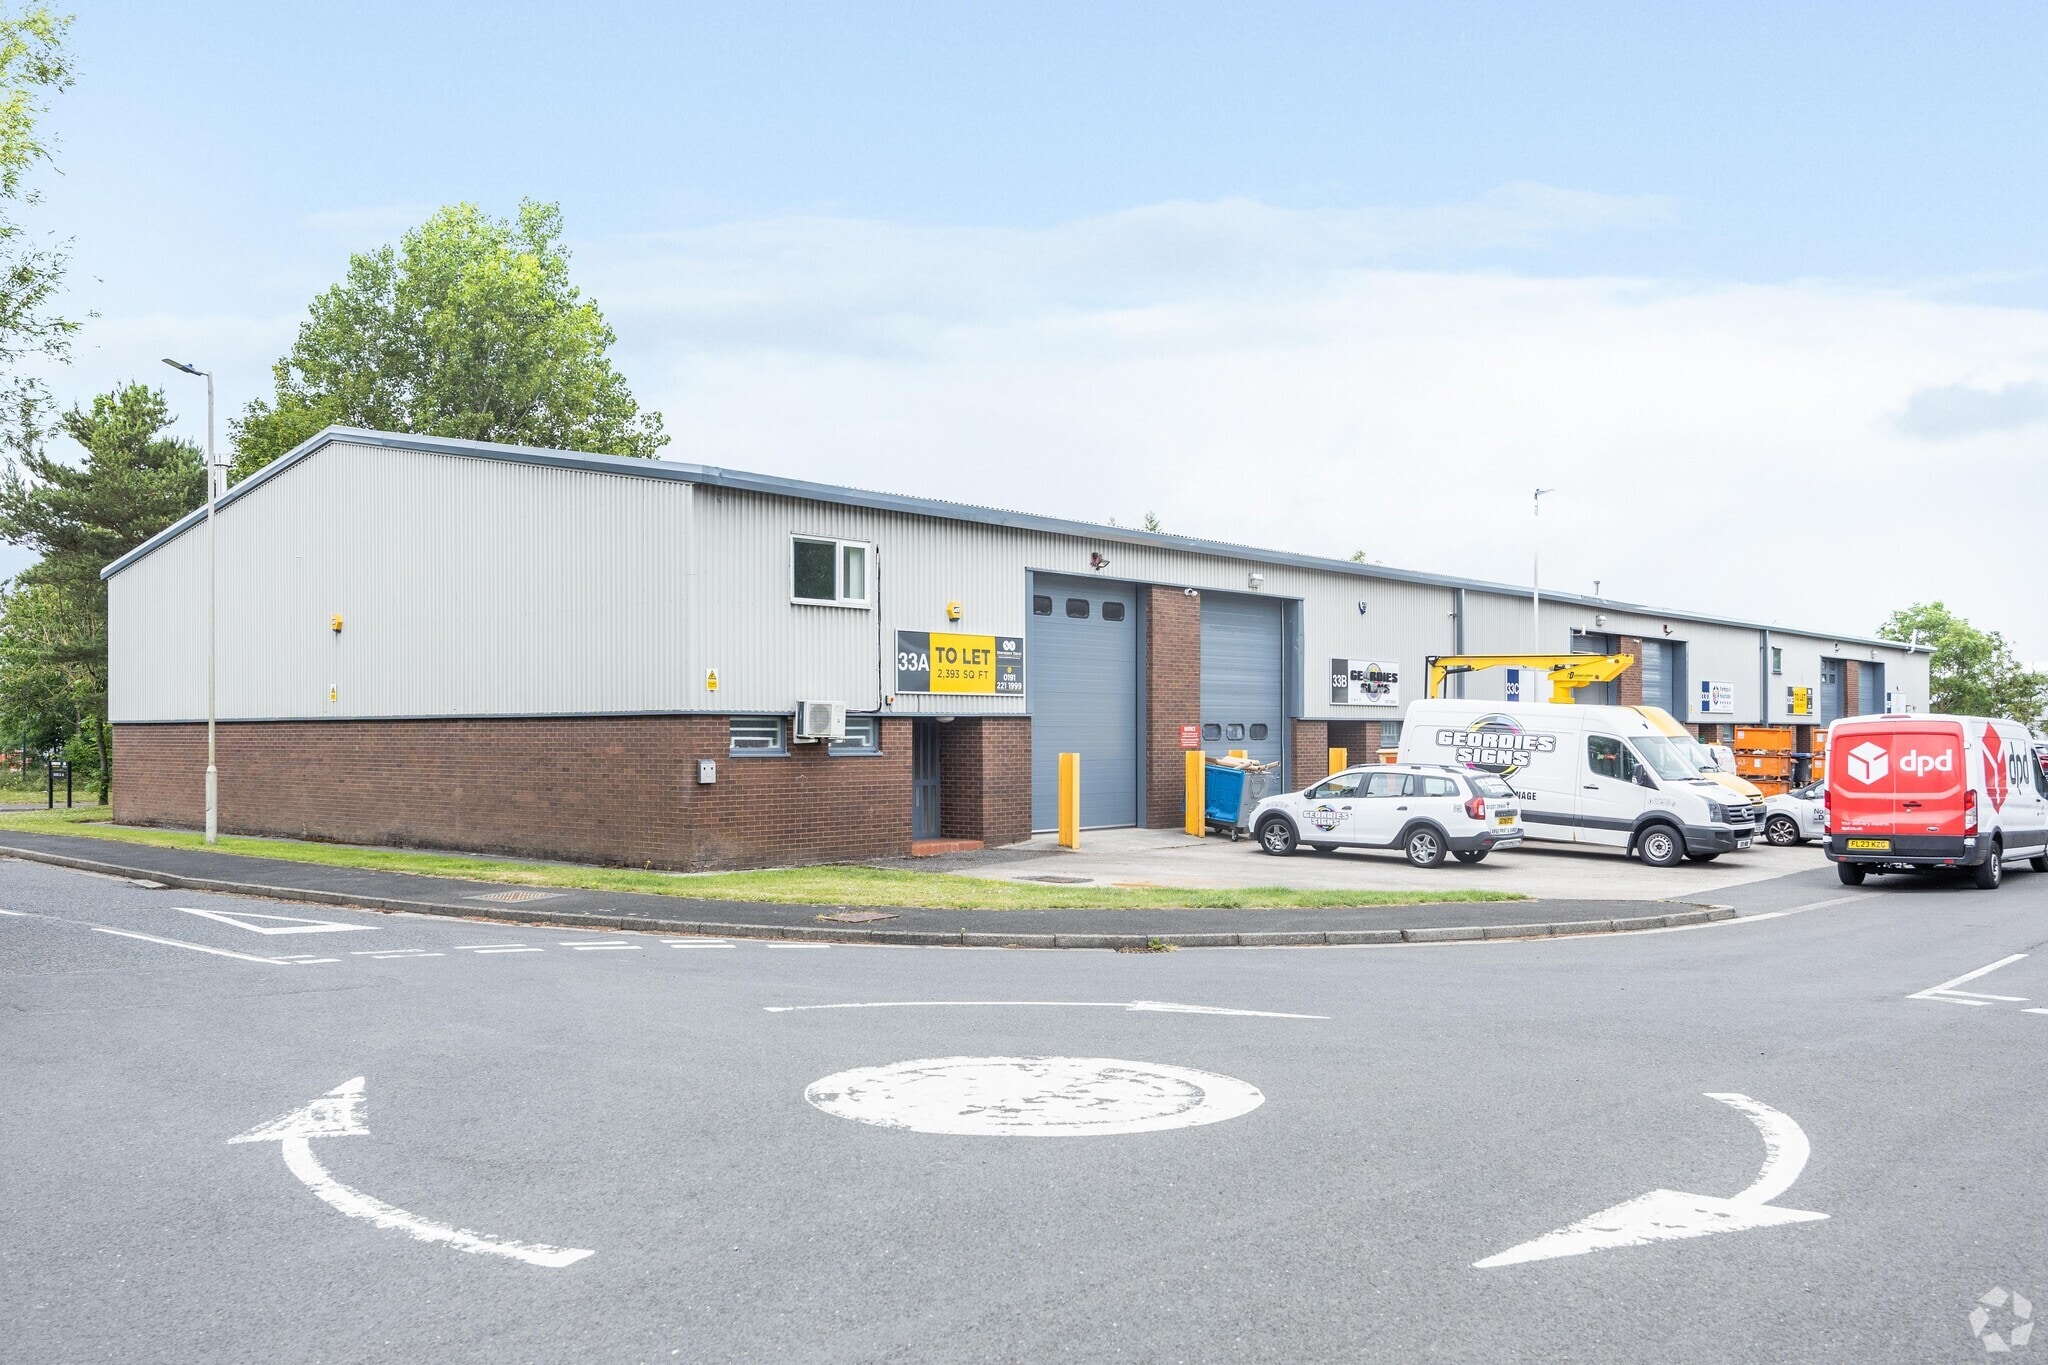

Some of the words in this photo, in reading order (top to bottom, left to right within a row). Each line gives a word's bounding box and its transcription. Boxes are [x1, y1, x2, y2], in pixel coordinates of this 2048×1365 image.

[898, 652, 930, 672] 33A
[935, 647, 958, 664] TO
[962, 648, 991, 665] LET
[937, 669, 960, 680] 2,393
[963, 670, 975, 679] SQ
[978, 671, 989, 680] FT
[1003, 673, 1016, 681] 0191
[1332, 674, 1348, 688] 33B
[1350, 669, 1399, 683] GEORDIES
[997, 681, 1007, 689] 221
[1008, 682, 1022, 690] 1999
[1506, 682, 1520, 695] 33C
[1437, 730, 1555, 752] GEORDIES
[1456, 747, 1531, 767] SIGNS
[1899, 749, 1952, 777] dpd
[2009, 741, 2030, 795] dpd
[1515, 791, 1537, 801] NAGE
[1303, 810, 1349, 820] GEORDIES
[1311, 818, 1341, 826] SIGNS
